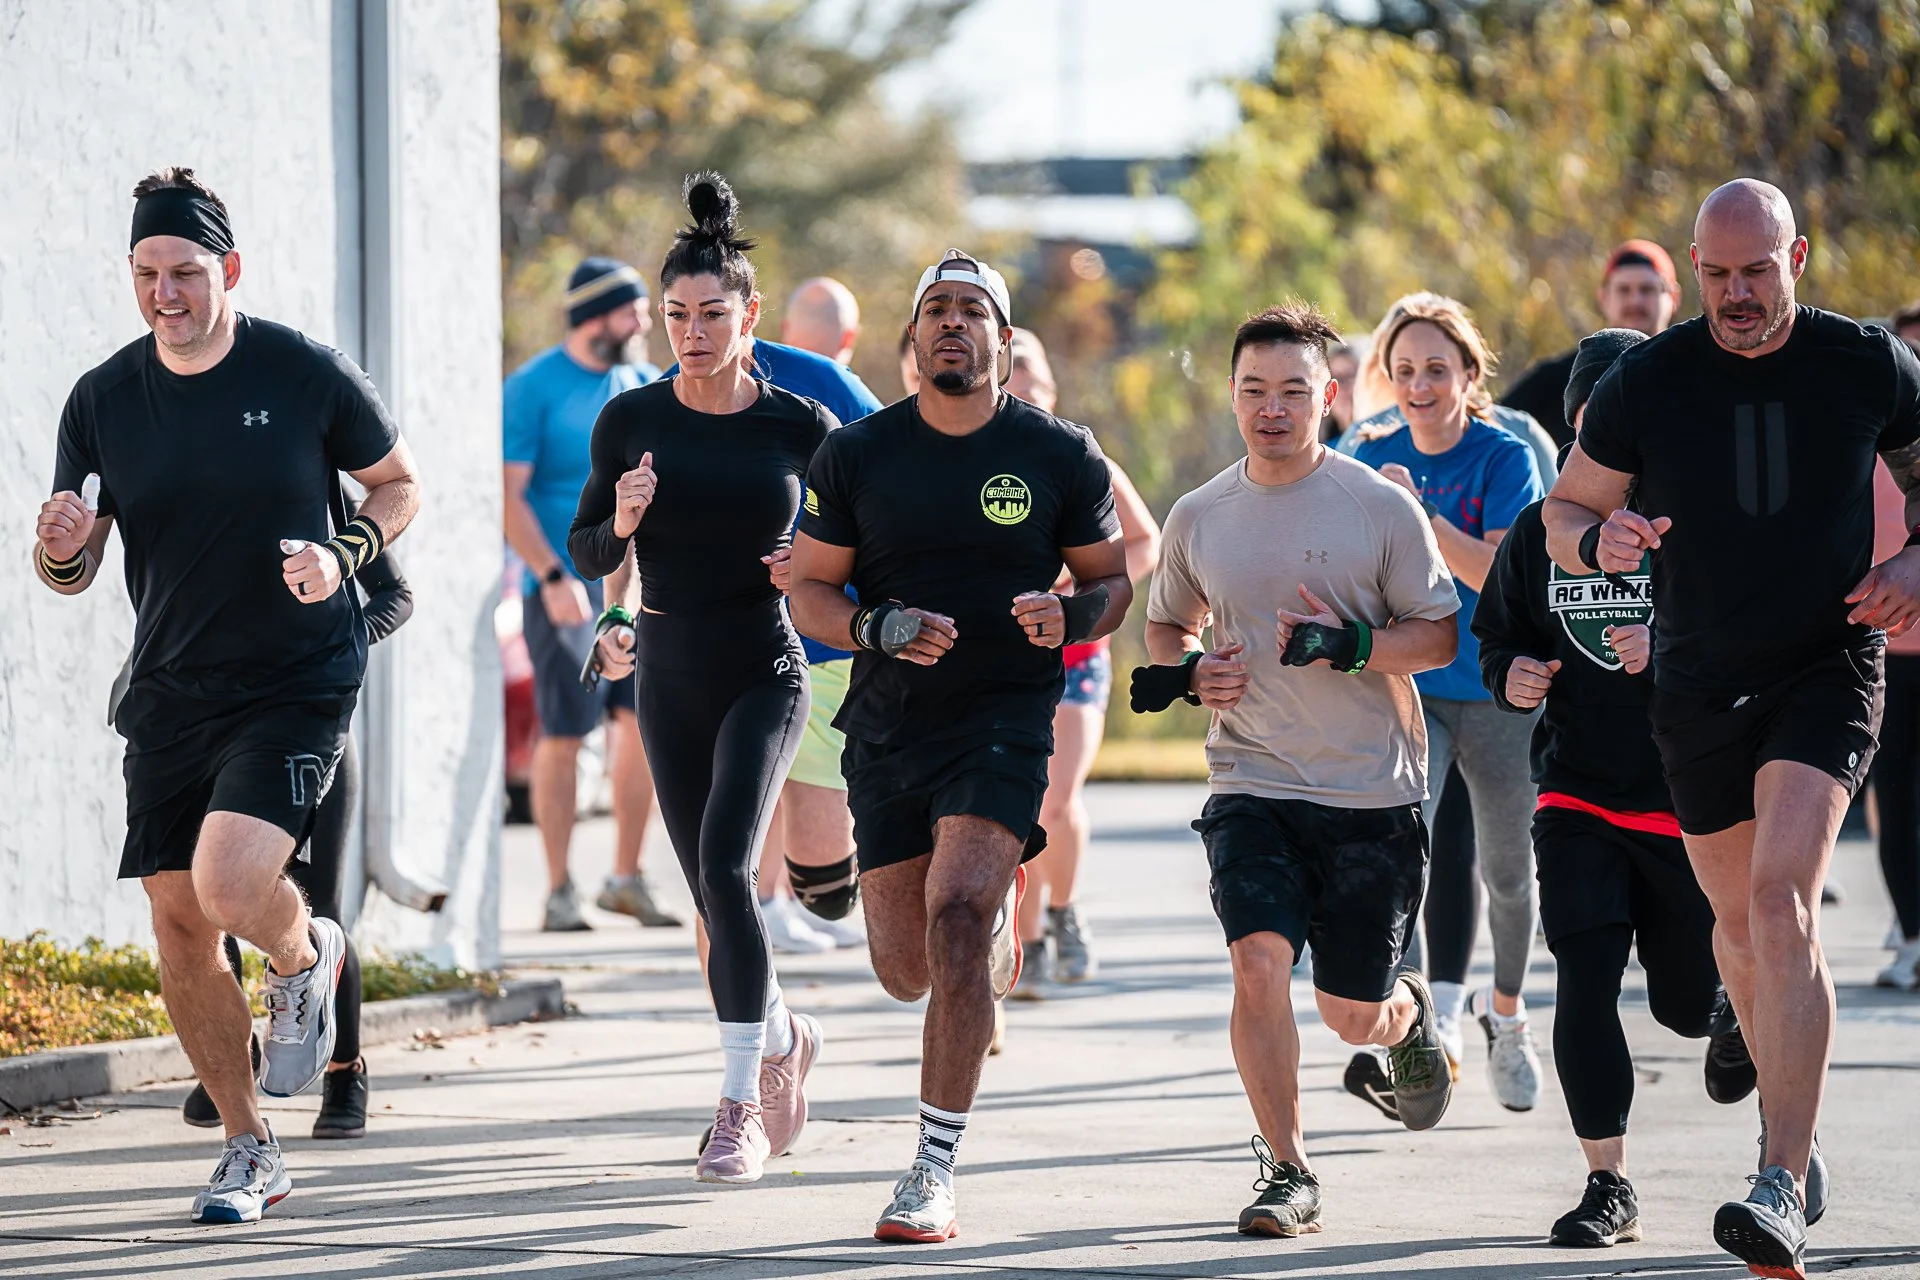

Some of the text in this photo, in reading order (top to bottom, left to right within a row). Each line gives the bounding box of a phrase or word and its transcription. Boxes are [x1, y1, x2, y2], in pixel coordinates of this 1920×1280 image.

[987, 487, 1025, 499] COMBINE
[1556, 586, 1583, 603] AG
[1569, 610, 1642, 620] VOLLEYBALL
